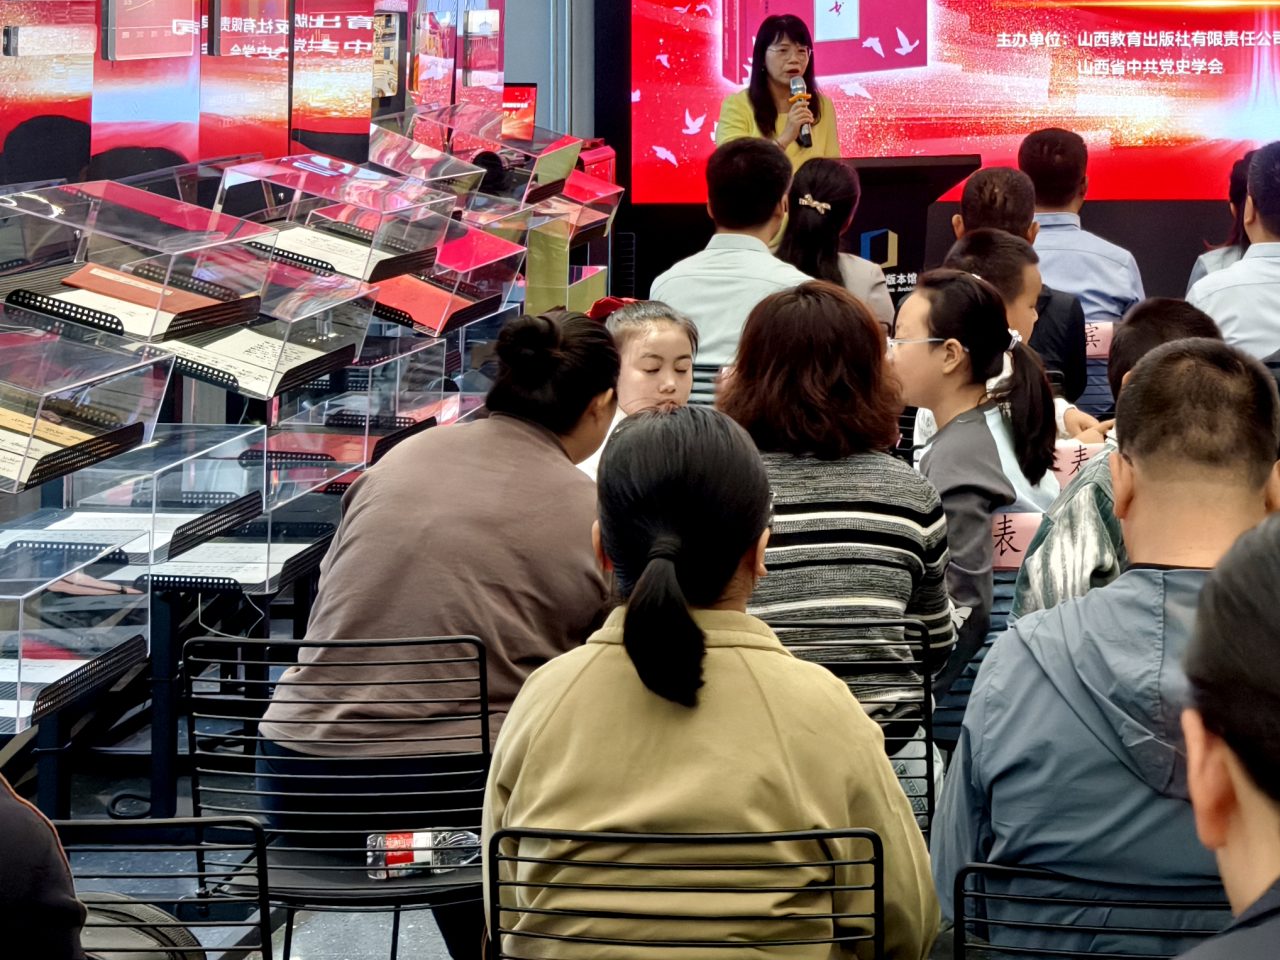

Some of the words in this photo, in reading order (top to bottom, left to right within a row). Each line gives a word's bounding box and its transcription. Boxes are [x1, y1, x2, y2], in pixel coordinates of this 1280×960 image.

[1077, 58, 1224, 75] 山西省中共党史学会
[993, 514, 1022, 556] 表
